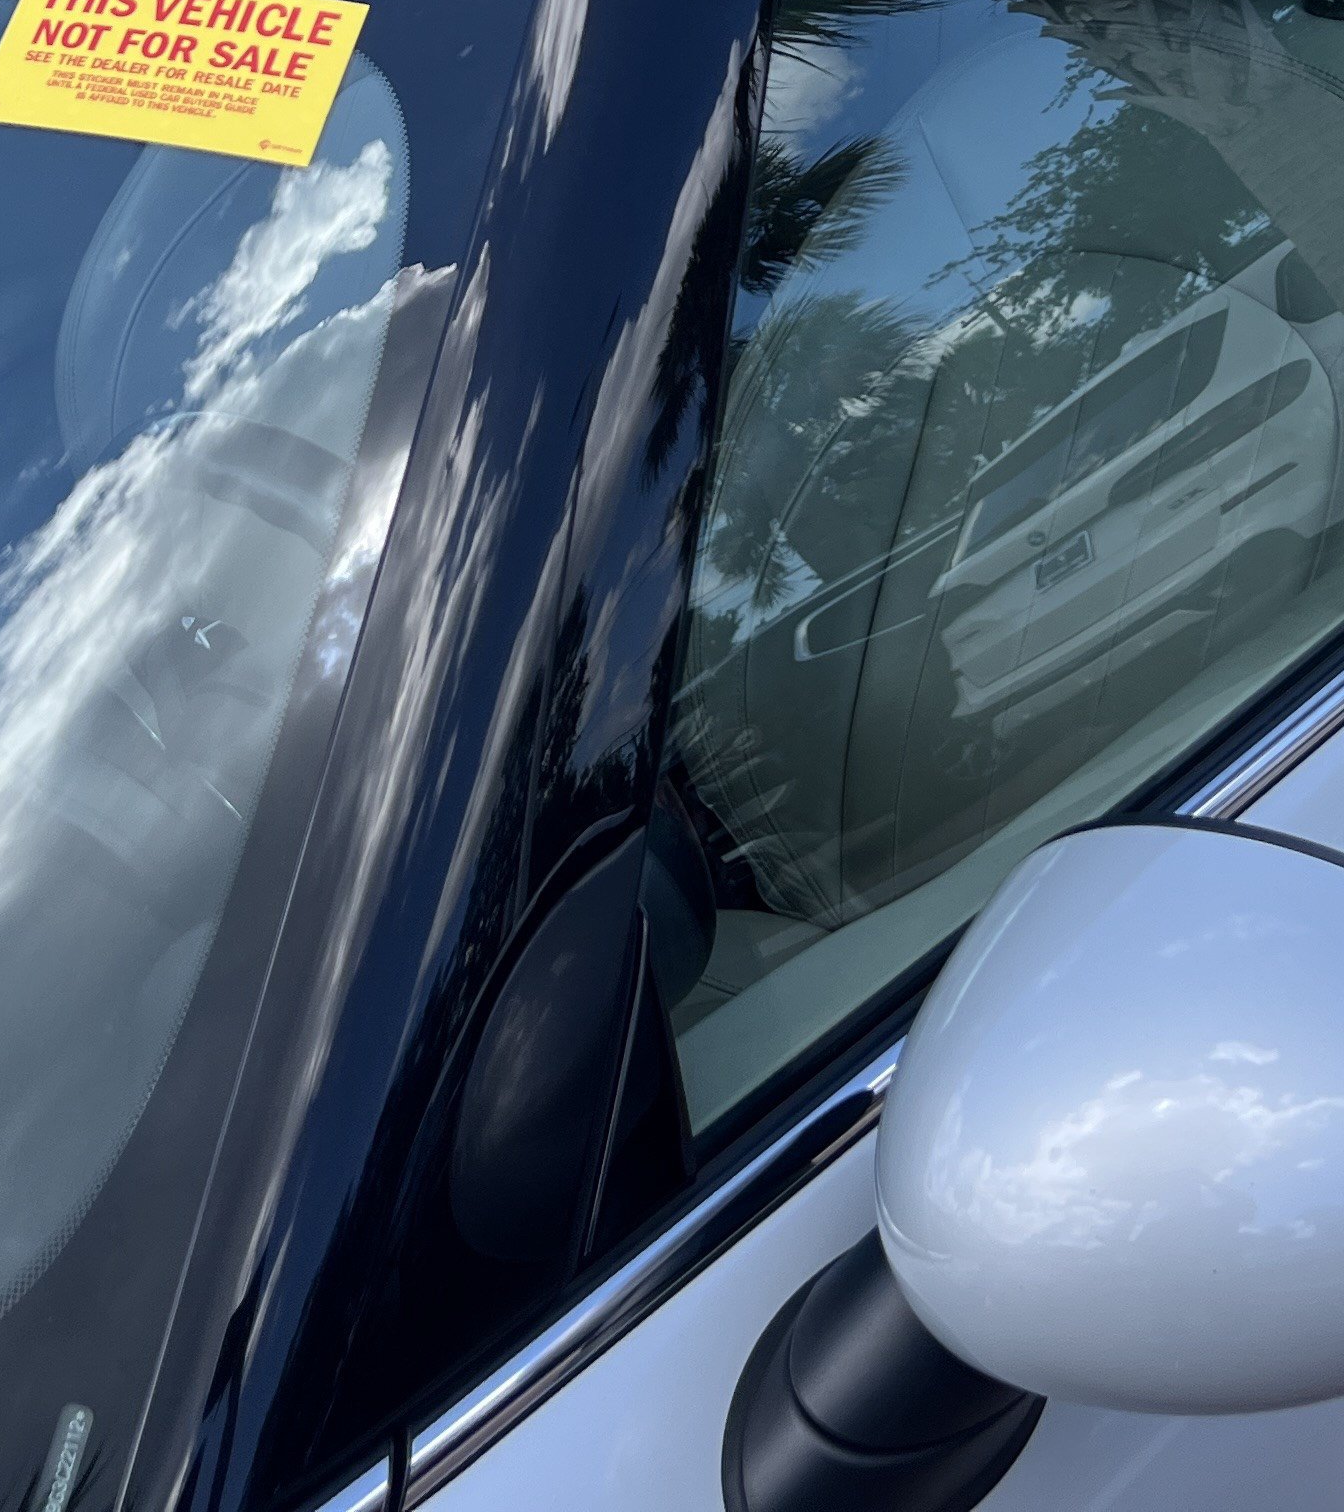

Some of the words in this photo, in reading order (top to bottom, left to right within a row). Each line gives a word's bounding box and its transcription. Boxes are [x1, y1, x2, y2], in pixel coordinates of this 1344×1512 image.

[32, 18, 113, 51] NOT
[117, 28, 199, 63] FOR
[208, 40, 315, 81] SALE
[25, 50, 54, 63] SEE
[58, 53, 89, 67] THE
[91, 57, 150, 76] DEALER
[155, 65, 188, 80] FOR
[193, 70, 256, 92] RESALE
[261, 80, 303, 99] DATE
[52, 70, 75, 79] THIS
[78, 73, 124, 85] STICKER
[127, 78, 158, 90] MUST
[161, 84, 206, 96] REMAIN
[208, 90, 220, 99] IN
[222, 93, 258, 105] PLACE
[46, 78, 73, 89] UNTIL
[85, 82, 127, 96] FEDERAL
[130, 89, 157, 100] USED
[160, 93, 181, 103] CAR
[224, 103, 257, 115] GUIDE
[132, 98, 146, 108] TO
[148, 101, 170, 111] THIS
